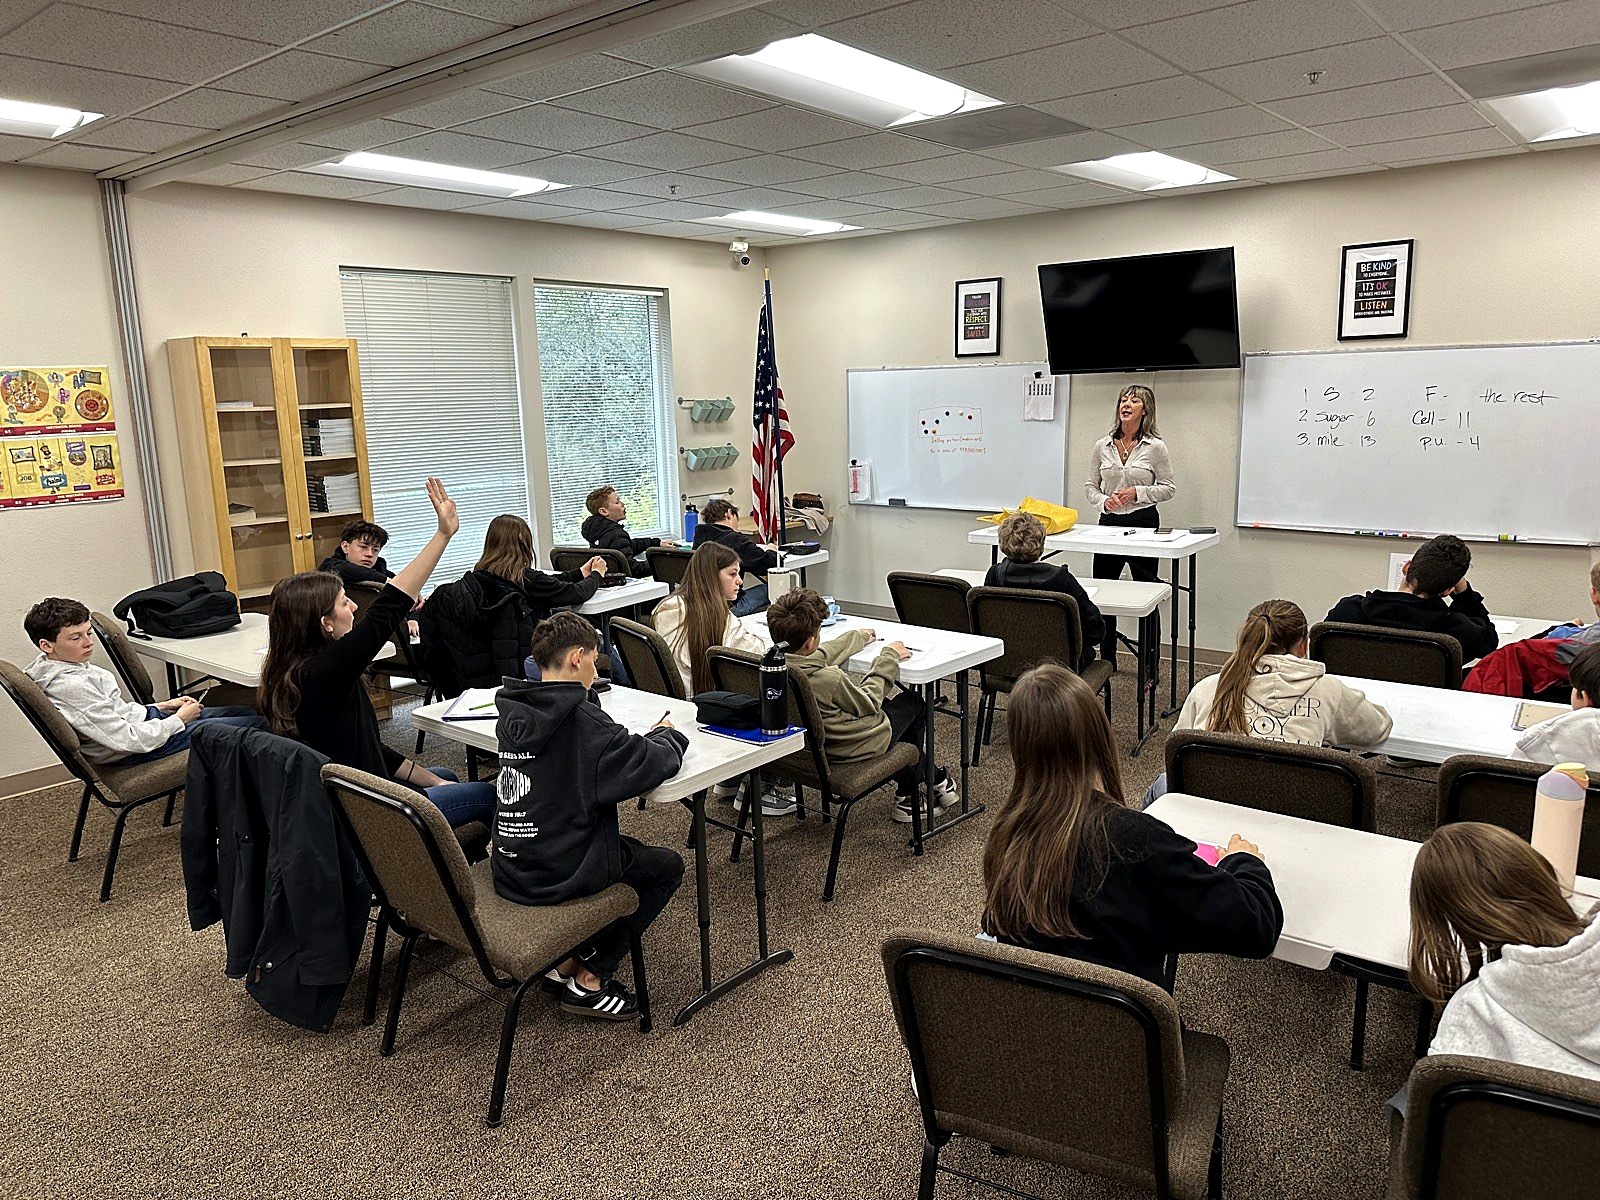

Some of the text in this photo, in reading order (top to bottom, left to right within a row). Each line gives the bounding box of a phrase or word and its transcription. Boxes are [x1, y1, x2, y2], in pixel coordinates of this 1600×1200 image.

[1360, 261, 1392, 272] BE KIND
[1376, 281, 1388, 290] OK
[1360, 301, 1388, 310] LISTEN
[966, 316, 988, 324] RESPECT
[1362, 388, 1376, 401] 2
[1479, 388, 1560, 405] the rest
[1360, 434, 1377, 448] 13
